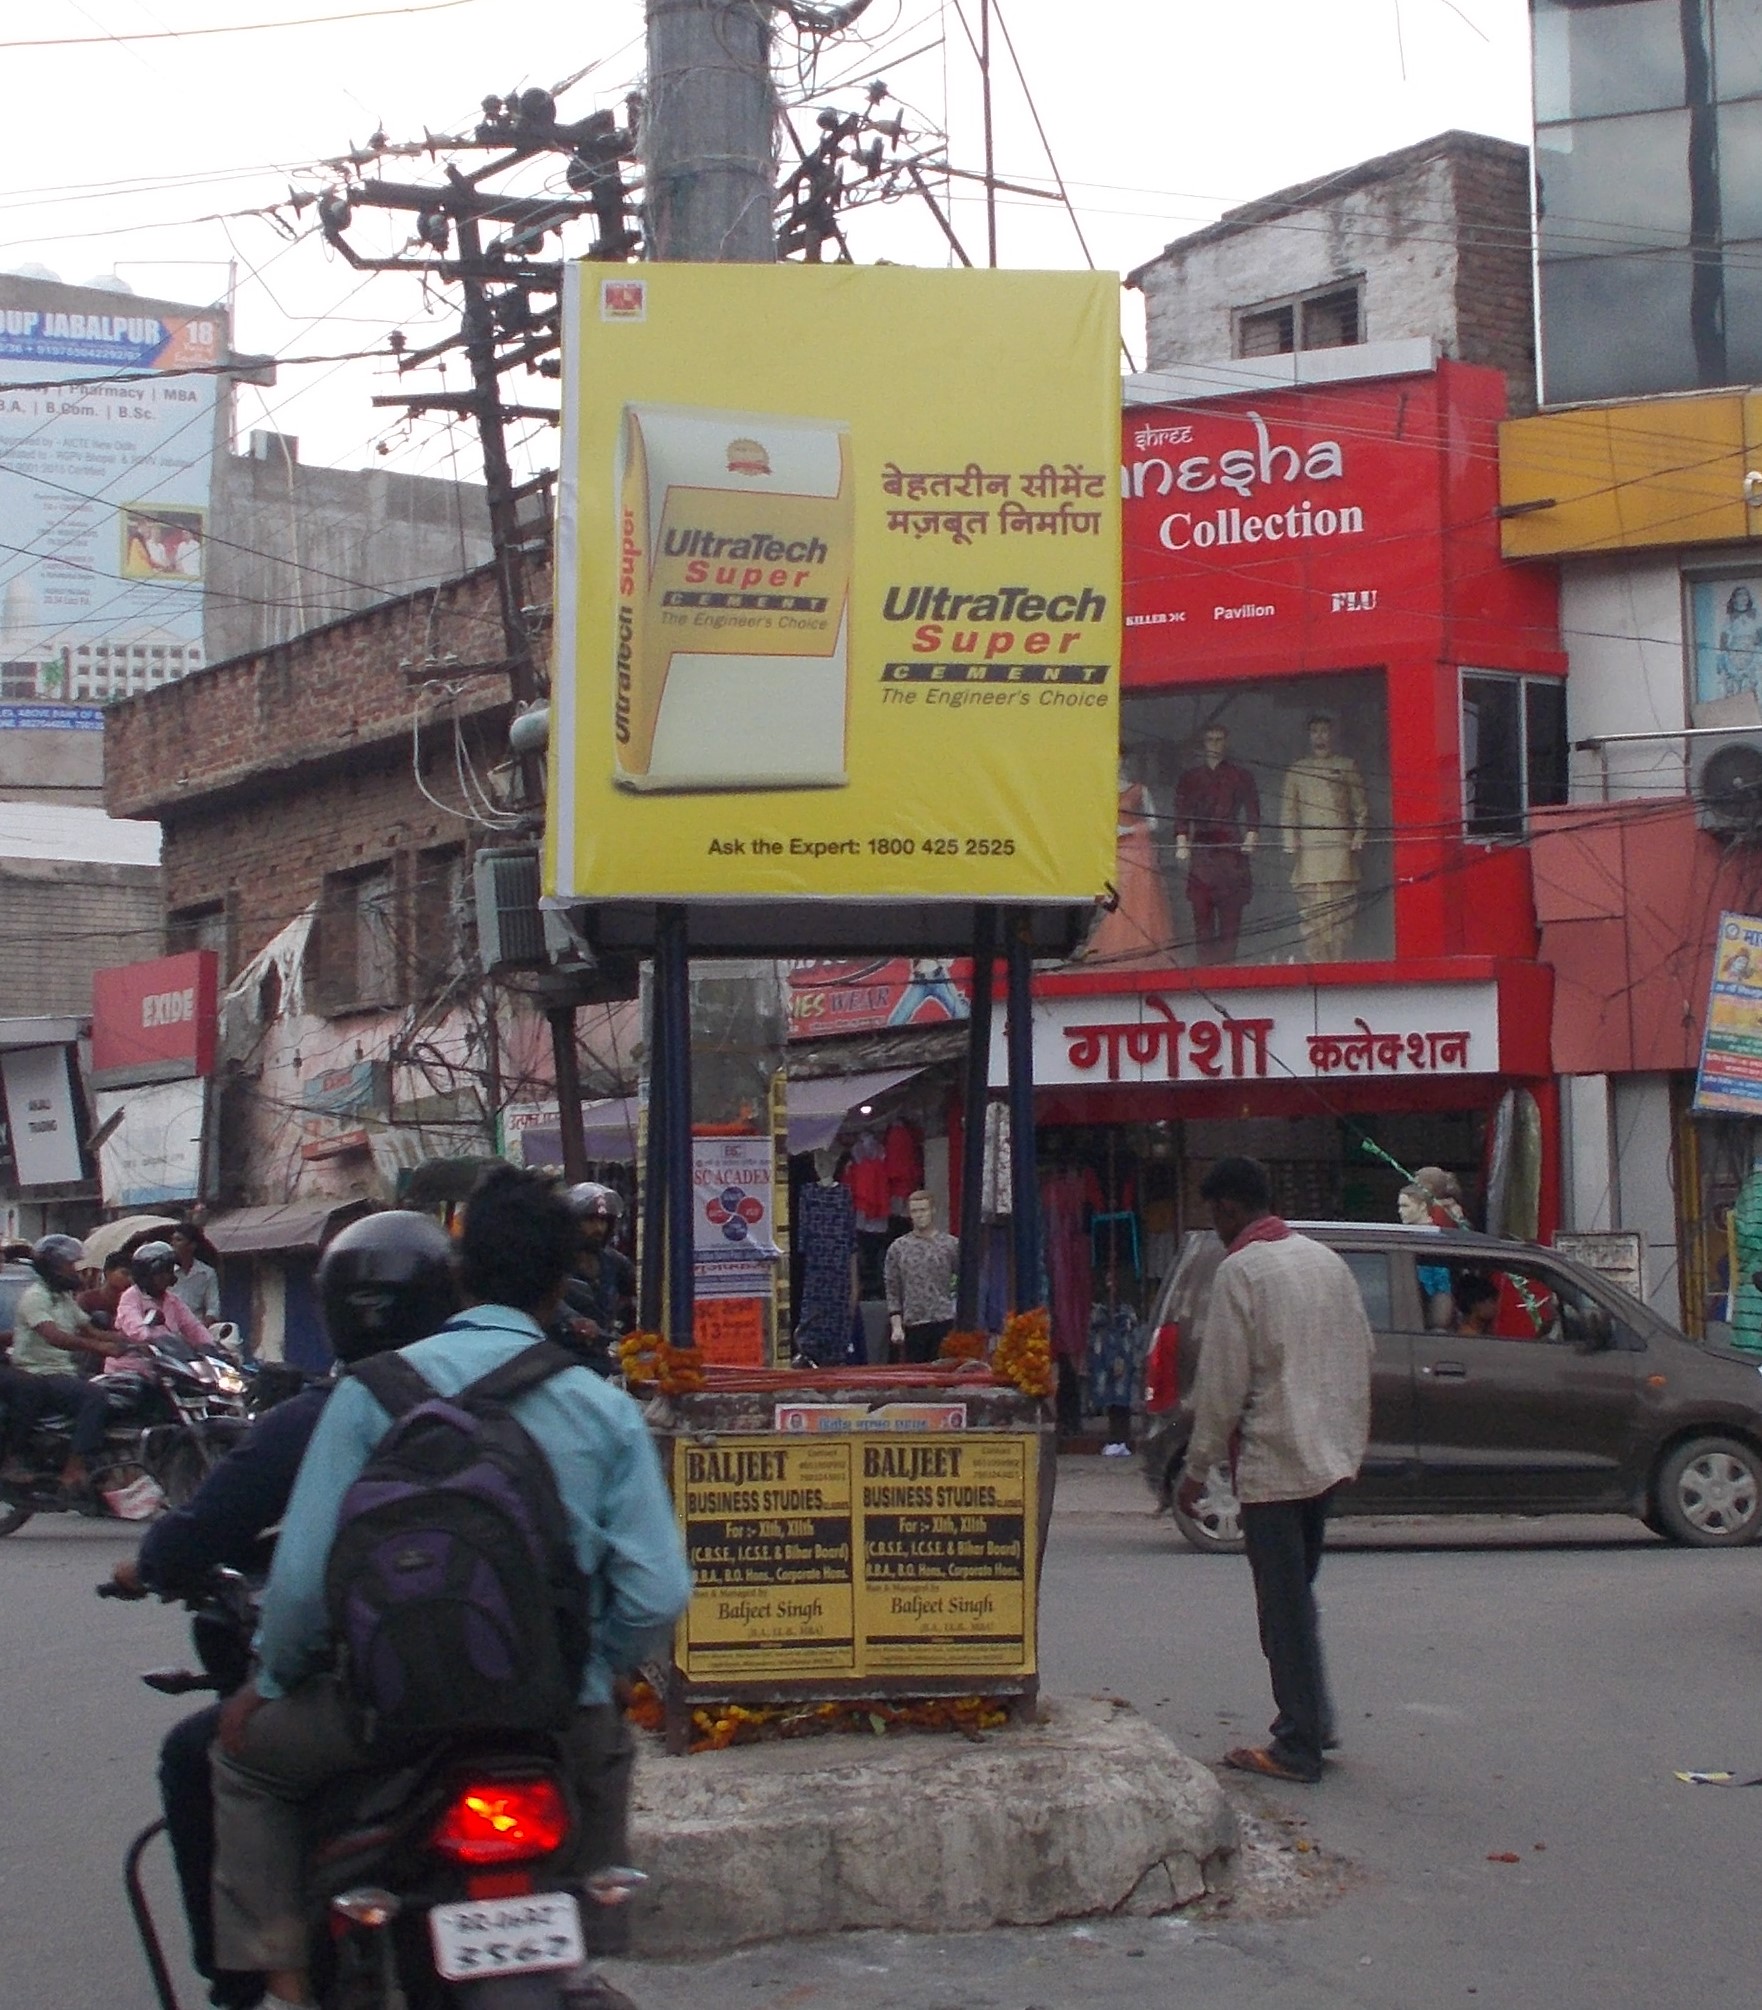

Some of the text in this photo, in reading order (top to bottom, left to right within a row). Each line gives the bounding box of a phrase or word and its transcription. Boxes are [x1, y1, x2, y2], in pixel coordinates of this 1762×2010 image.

[43, 312, 160, 346] JABALPUR
[70, 385, 197, 402] Pharmacy MBA
[118, 406, 156, 420] B.Sc.
[1121, 411, 1343, 499] nesha
[881, 462, 1106, 501] बेहतरीन सीमेंट
[997, 501, 1103, 536] निर्माण
[1159, 501, 1364, 550] Collection
[664, 527, 829, 564] UltraTech
[685, 560, 811, 590] Super
[669, 592, 821, 611] CEMENT
[882, 586, 1107, 623] UltraTech
[1214, 604, 1275, 620] Pavilion
[1331, 590, 1378, 613] FLU
[616, 504, 642, 744] UltraTech Super
[661, 611, 829, 630] The Engineer's Choice
[912, 624, 1081, 660] Super
[892, 665, 1099, 681] CEMENT
[883, 688, 1109, 708] The Engineer's Choice
[708, 838, 1015, 858] Ask the Expert: 1800 425 2525
[143, 988, 194, 1028] EXIDE
[1306, 1017, 1471, 1072] कलेक्शन
[688, 1450, 789, 1486] BALJEET
[864, 1447, 962, 1481] BALJEET
[688, 1488, 823, 1514] BUSINESS STUDIES
[864, 1485, 996, 1508] BUSINESS STUDIES
[900, 1517, 916, 1533] For
[718, 1597, 823, 1627] Baljeet Singh
[890, 1592, 993, 1621] Baljeet Singh
